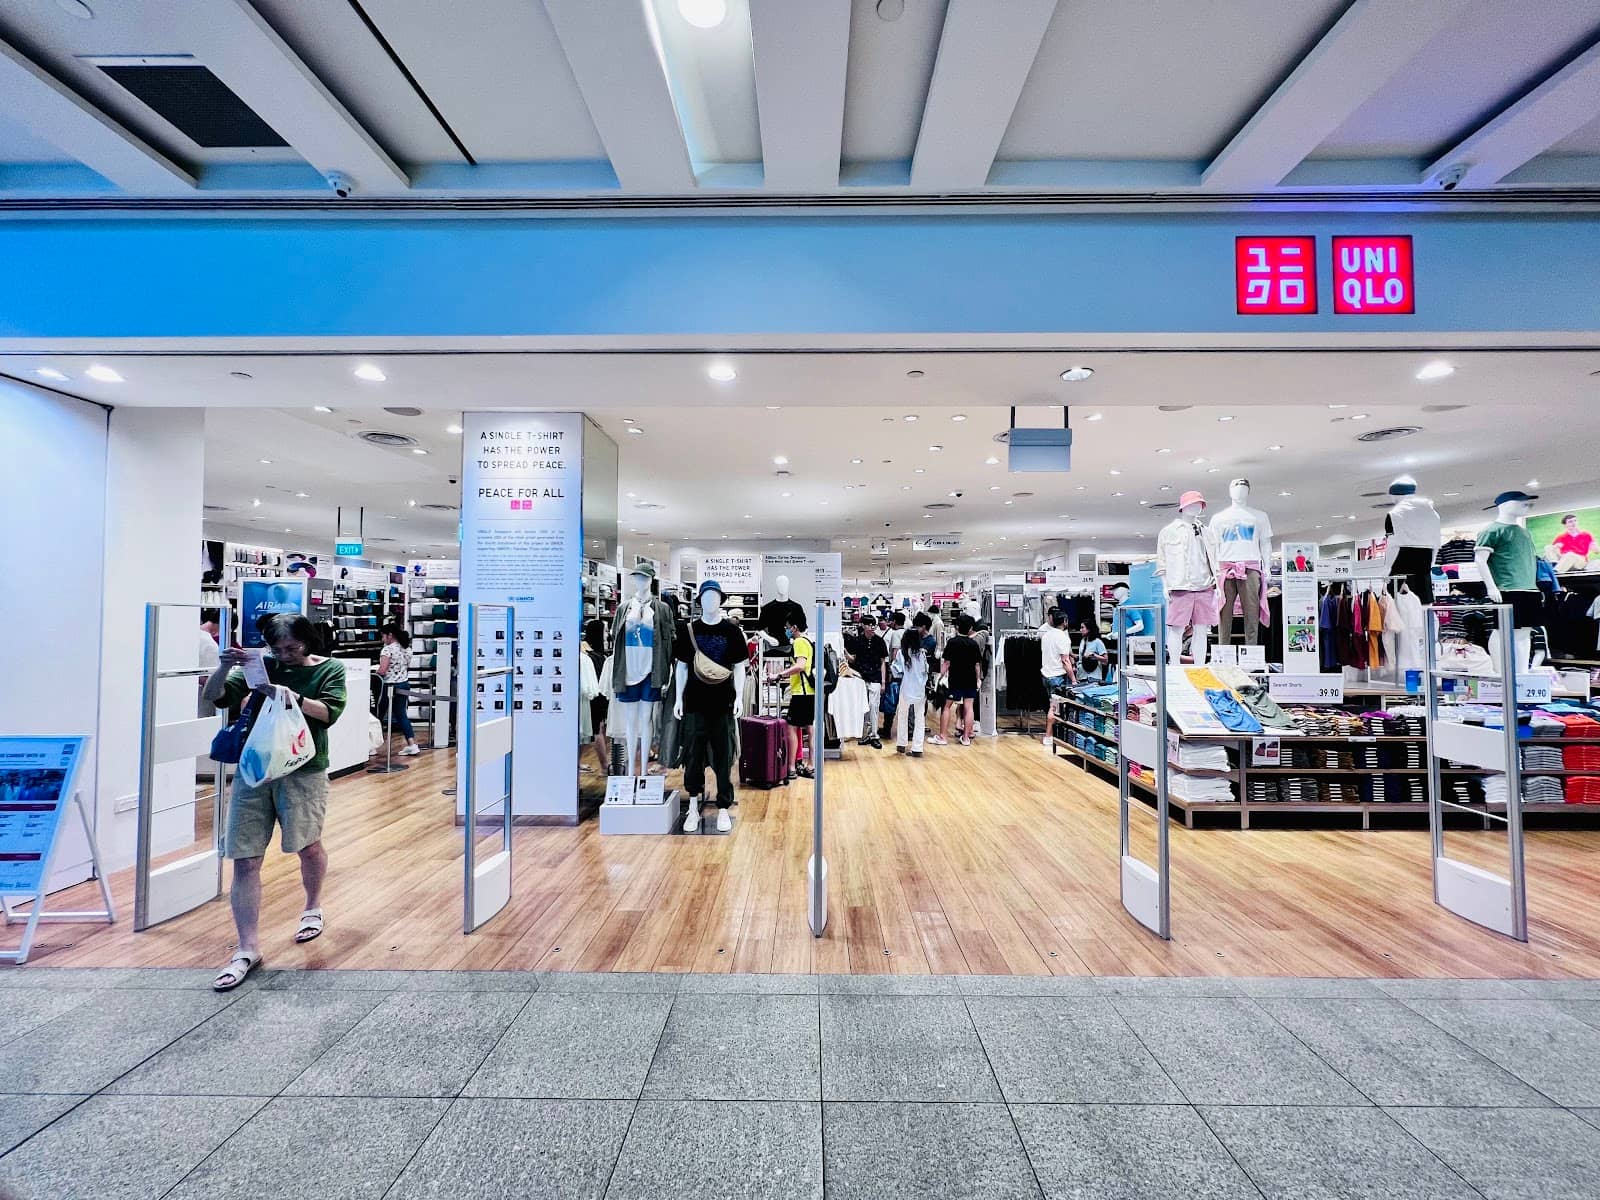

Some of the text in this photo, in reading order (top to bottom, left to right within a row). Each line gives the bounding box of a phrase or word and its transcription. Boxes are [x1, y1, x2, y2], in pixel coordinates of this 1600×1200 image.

[1247, 247, 1303, 273] ユニ
[1341, 247, 1397, 273] UNI
[1246, 279, 1305, 304] クロ
[1342, 278, 1404, 309] QLO
[480, 431, 565, 440] A SINGLE T-SHIRT
[483, 446, 561, 455] HAS THE POWER
[477, 460, 567, 470] TO SPREAD PEACE.
[478, 488, 565, 498] PEACE FOR ALL
[339, 545, 355, 555] EXIT
[1319, 688, 1339, 697] 39.90
[1527, 688, 1547, 698] 29.90
